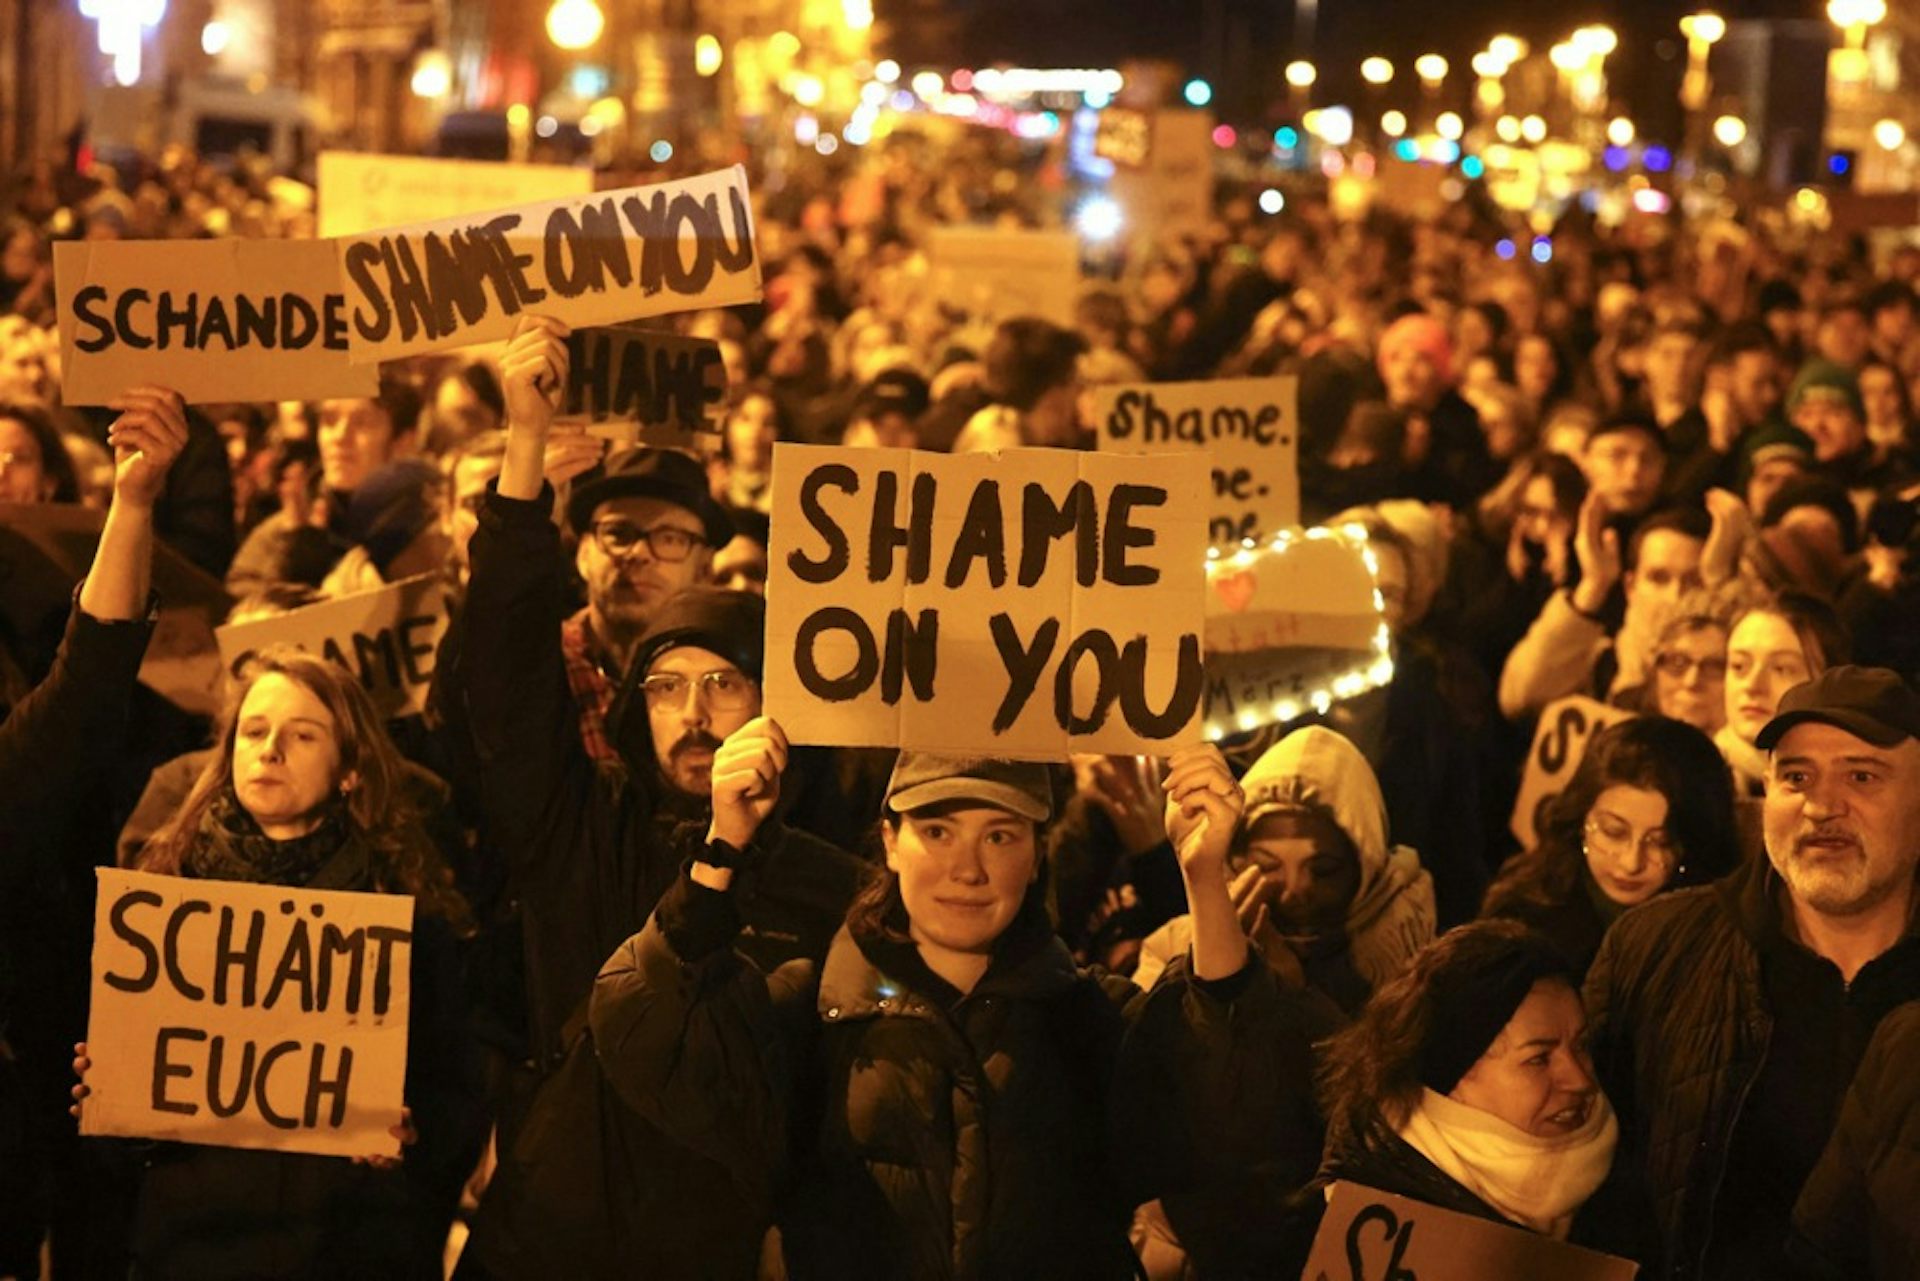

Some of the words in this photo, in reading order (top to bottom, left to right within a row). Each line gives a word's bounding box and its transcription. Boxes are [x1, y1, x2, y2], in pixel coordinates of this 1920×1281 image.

[72, 285, 350, 354] SCHANDE
[345, 214, 547, 343] SHAME
[543, 195, 634, 299] ON
[621, 185, 754, 298] YOU
[566, 330, 723, 432] HAME
[1107, 389, 1291, 447] Shame.
[787, 462, 1169, 590] SHAME
[793, 606, 940, 707] ON
[988, 611, 1205, 740] YOU
[103, 889, 412, 1016] SCHÄMT
[151, 1026, 354, 1131] EUCH
